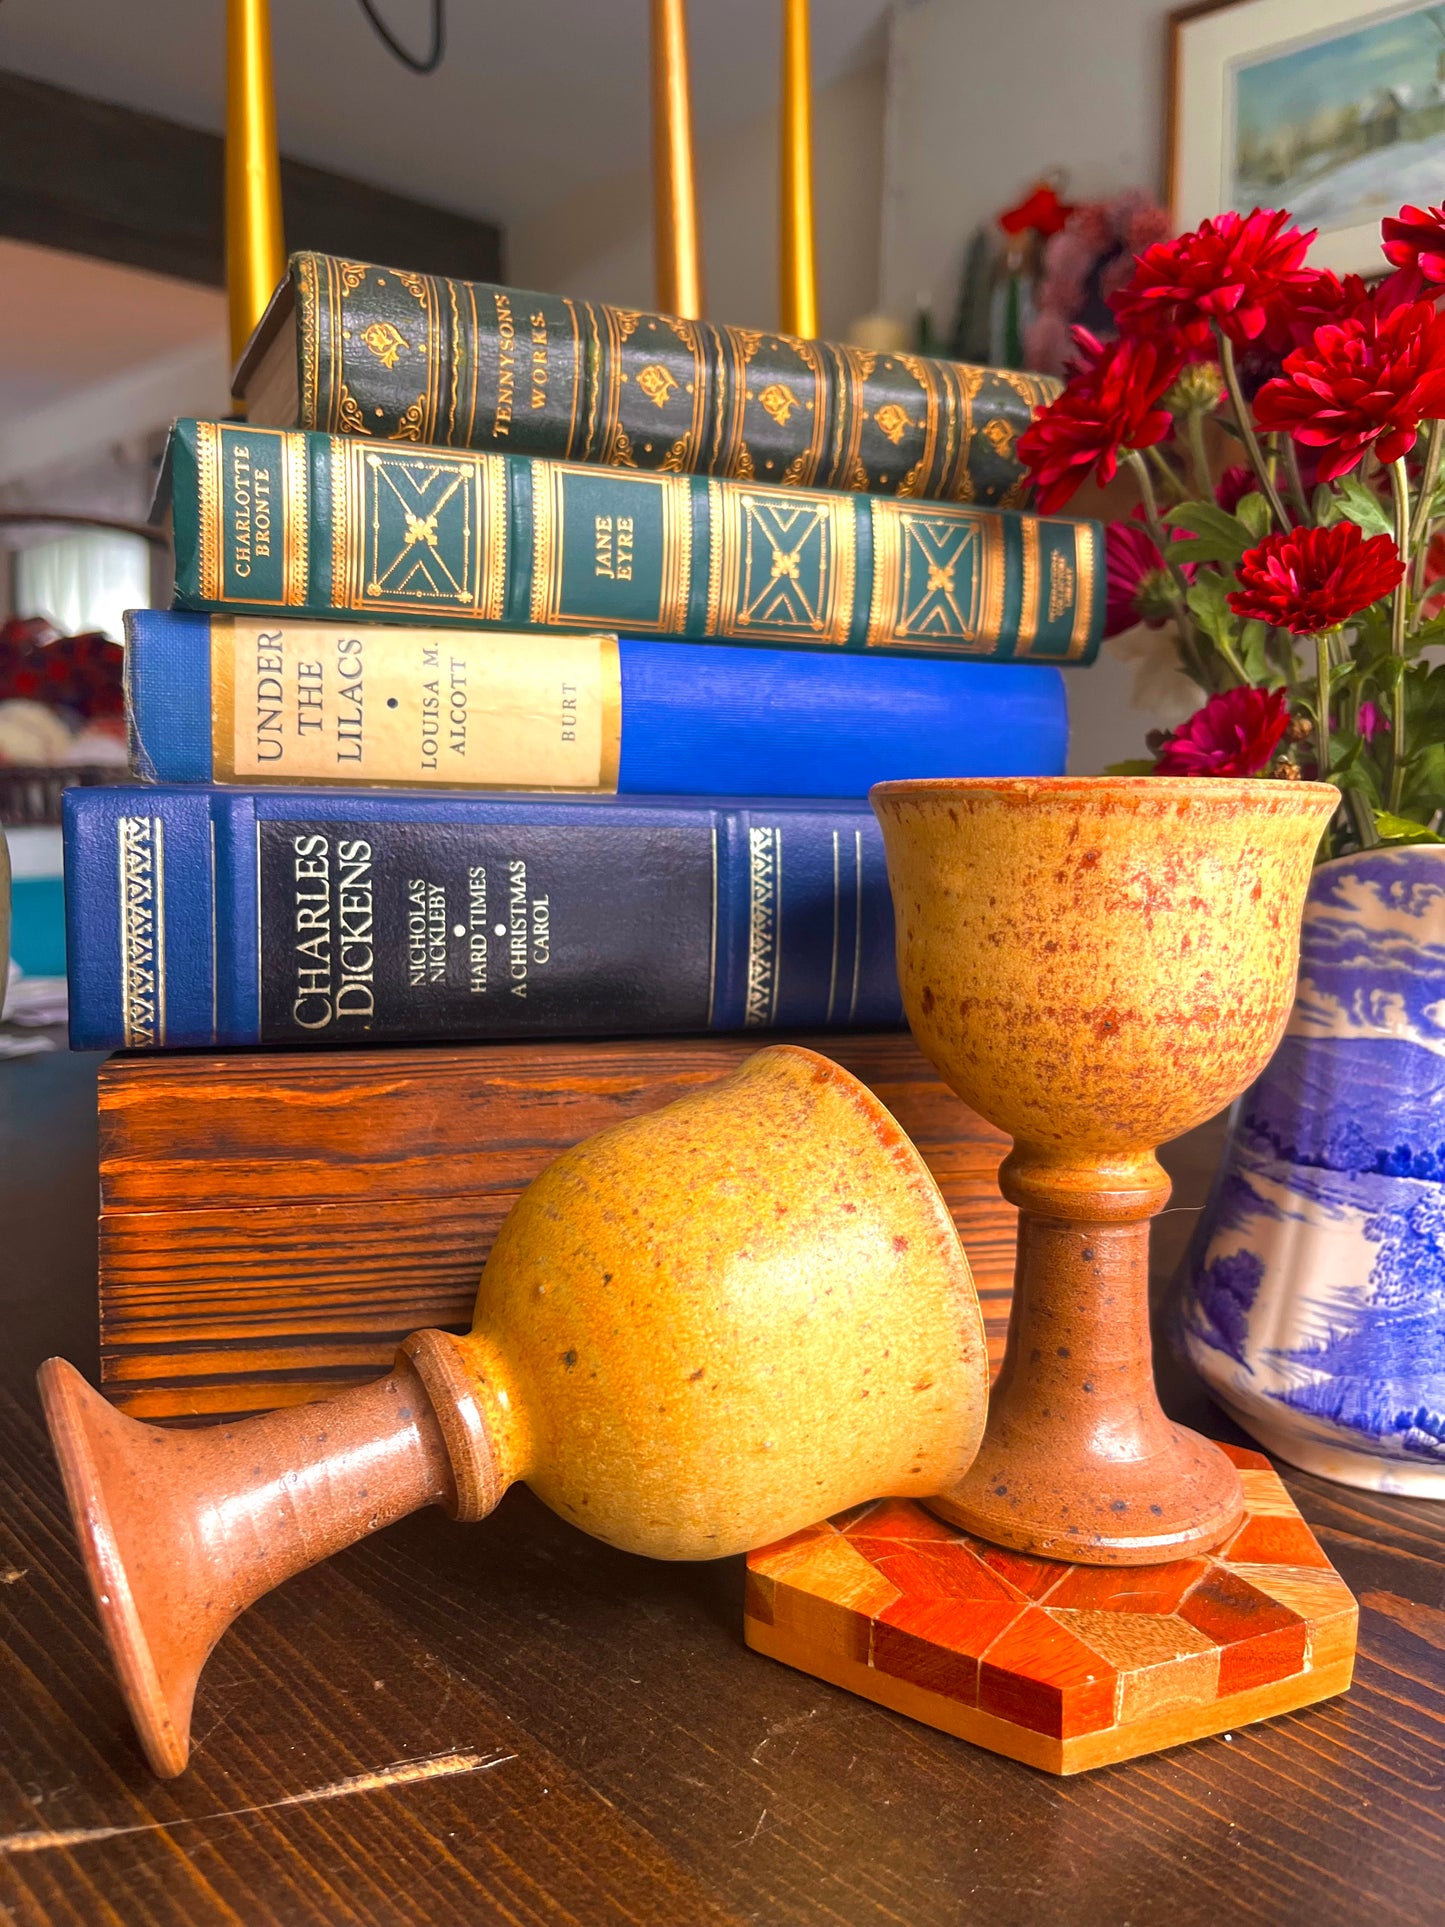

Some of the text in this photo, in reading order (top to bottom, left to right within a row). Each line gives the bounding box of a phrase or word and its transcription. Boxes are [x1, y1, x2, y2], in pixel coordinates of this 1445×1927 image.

[492, 294, 514, 437] TENNYSON'S
[234, 445, 251, 579] CHARLOTTE
[255, 468, 270, 558] BRONTE
[595, 514, 614, 579] JANE
[616, 516, 634, 581] EYRE
[257, 630, 284, 763] UNDER
[297, 661, 323, 736] THE
[338, 638, 363, 763] LILACS
[421, 642, 439, 769] LOUISA M.
[450, 657, 467, 755] ALCOTT
[562, 683, 577, 742] BURT
[294, 834, 331, 1030] CHARLES
[336, 840, 374, 1020] DICKENS
[408, 879, 427, 986] NICHOLAS
[428, 883, 446, 983] NICKLEBY
[469, 866, 487, 993] HARD TIMES
[509, 860, 527, 999] A CHRISTMAS
[533, 894, 550, 965] CAROL
